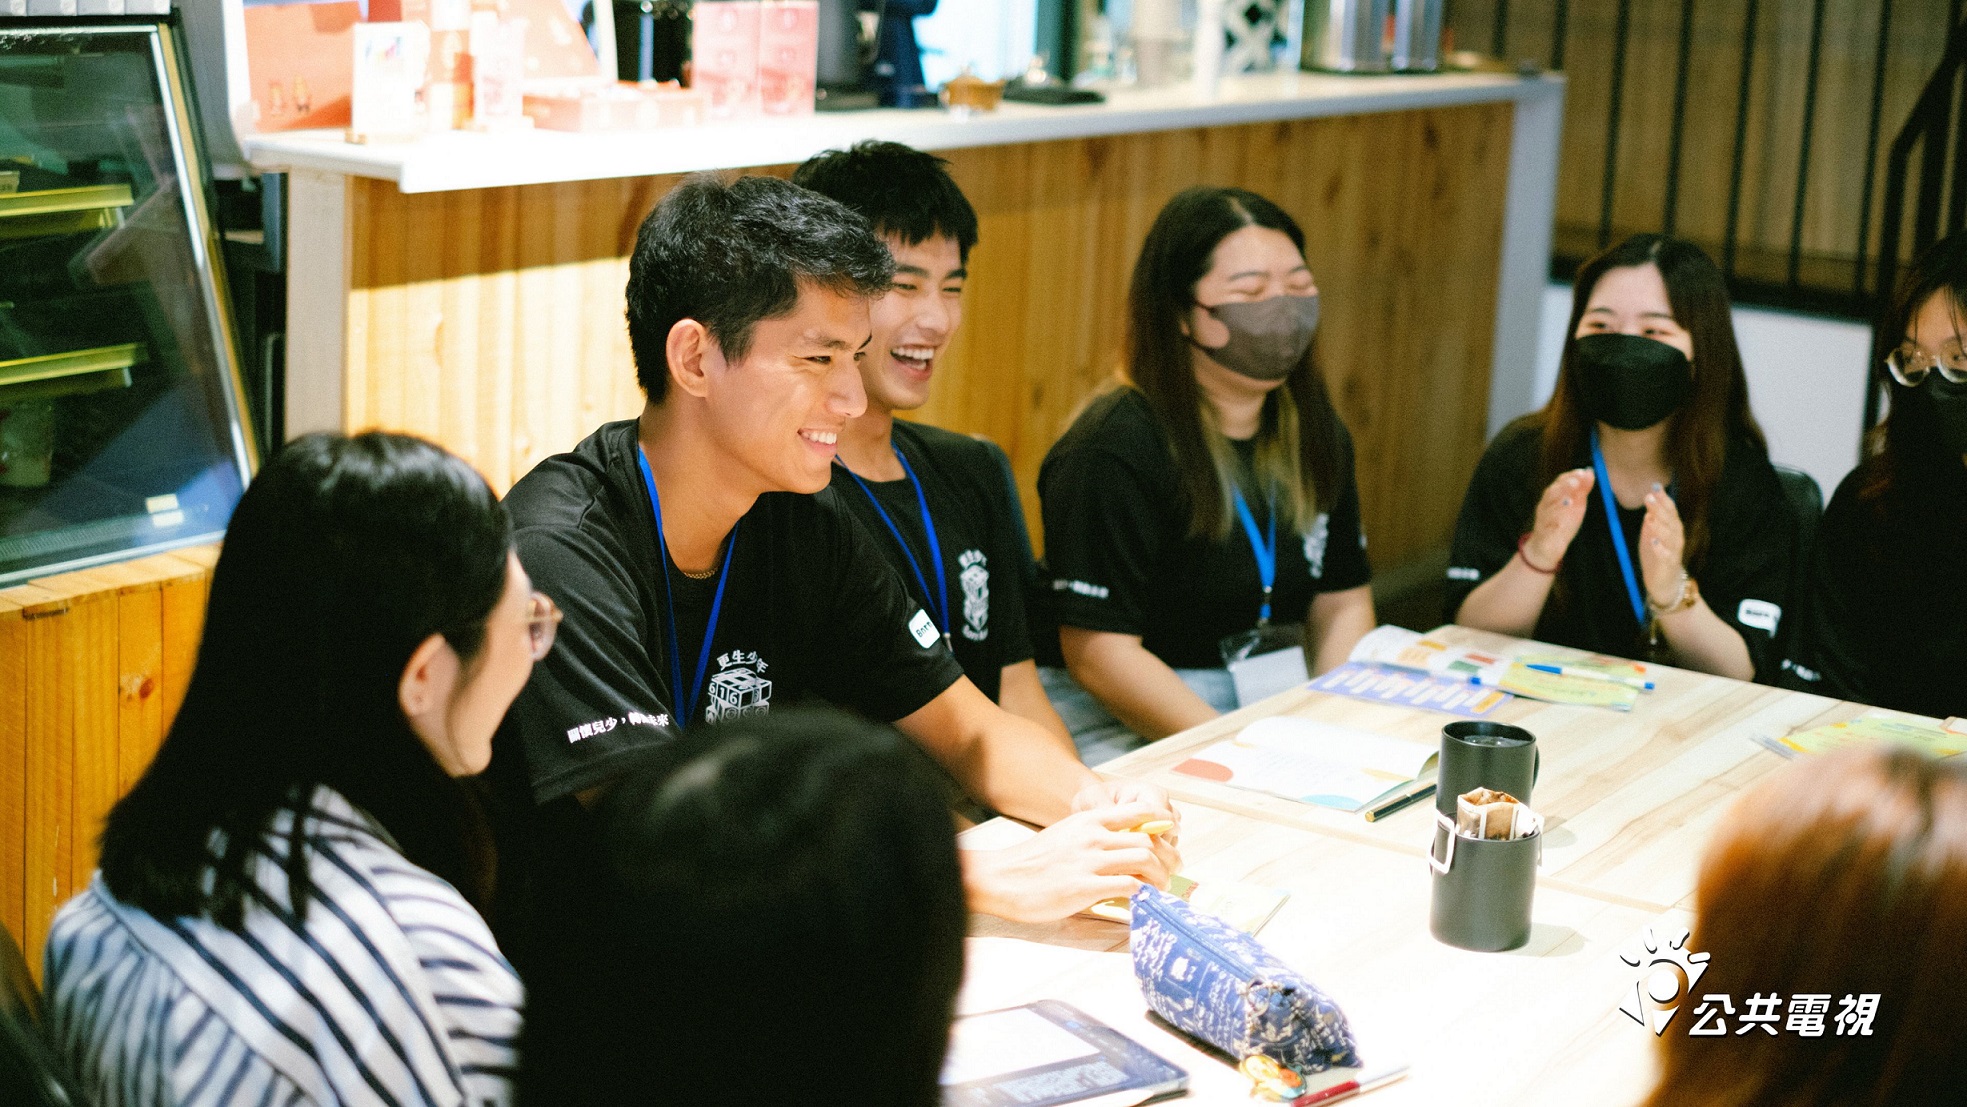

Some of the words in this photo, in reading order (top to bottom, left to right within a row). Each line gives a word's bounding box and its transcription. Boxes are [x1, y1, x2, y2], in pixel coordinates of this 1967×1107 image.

[716, 649, 769, 673] 更生少年
[708, 682, 738, 705] 616
